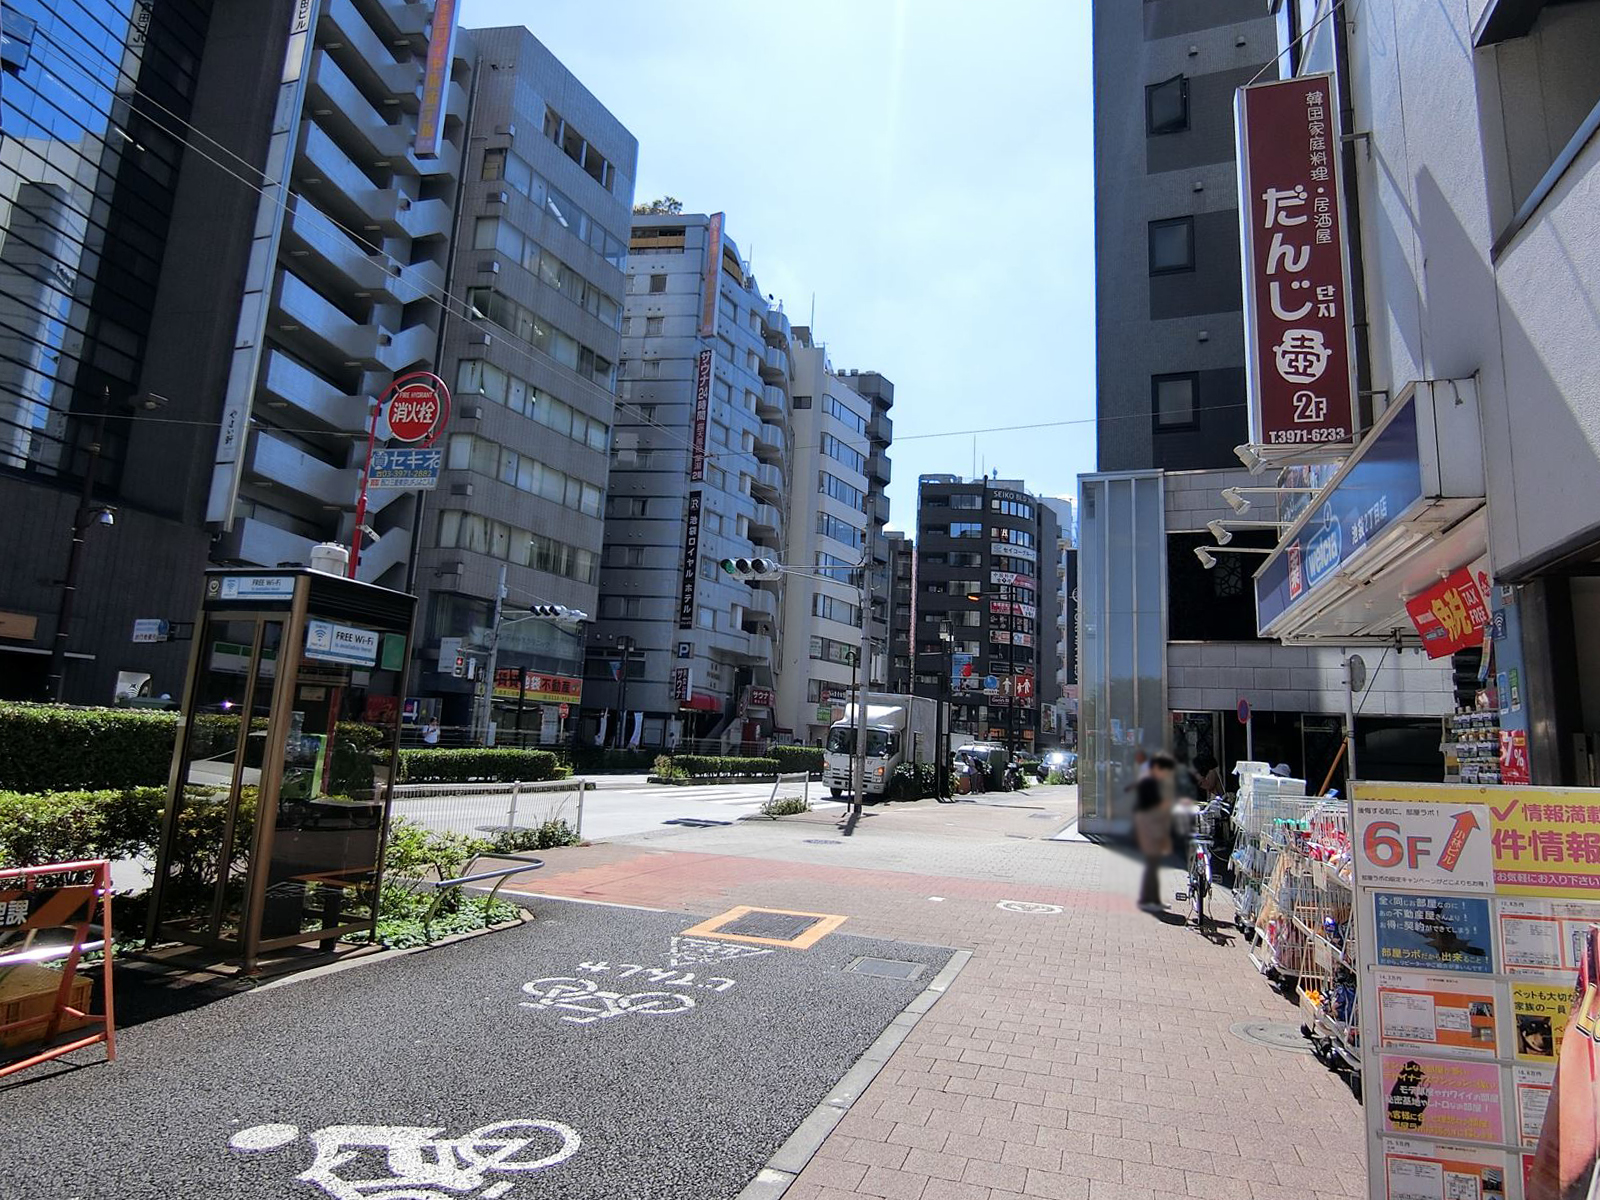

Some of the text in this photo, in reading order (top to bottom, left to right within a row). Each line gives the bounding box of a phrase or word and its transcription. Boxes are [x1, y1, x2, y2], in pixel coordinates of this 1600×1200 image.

[1305, 91, 1333, 245] 韓国家庭料理・居酒屋
[1262, 184, 1314, 322] だんじ
[1316, 286, 1336, 318] 단지
[391, 401, 436, 423] 消火栓
[1293, 391, 1327, 423] 2F
[1269, 426, 1345, 444] T.3971-6233
[389, 451, 441, 469] セキネ
[993, 490, 1014, 499] SEIKO
[252, 578, 282, 587] FREE Wi-Fi
[682, 583, 693, 613] ホテル
[1462, 588, 1479, 607] TAX
[1468, 606, 1487, 625] FREE
[335, 631, 374, 646] FREE Wi-Fi
[678, 643, 690, 657] P
[752, 690, 769, 699] サウナ
[1363, 820, 1433, 870] 6F
[1443, 830, 1466, 866] 小林ビル
[0, 900, 29, 926] 課
[1514, 1002, 1567, 1015] 家族の一員
